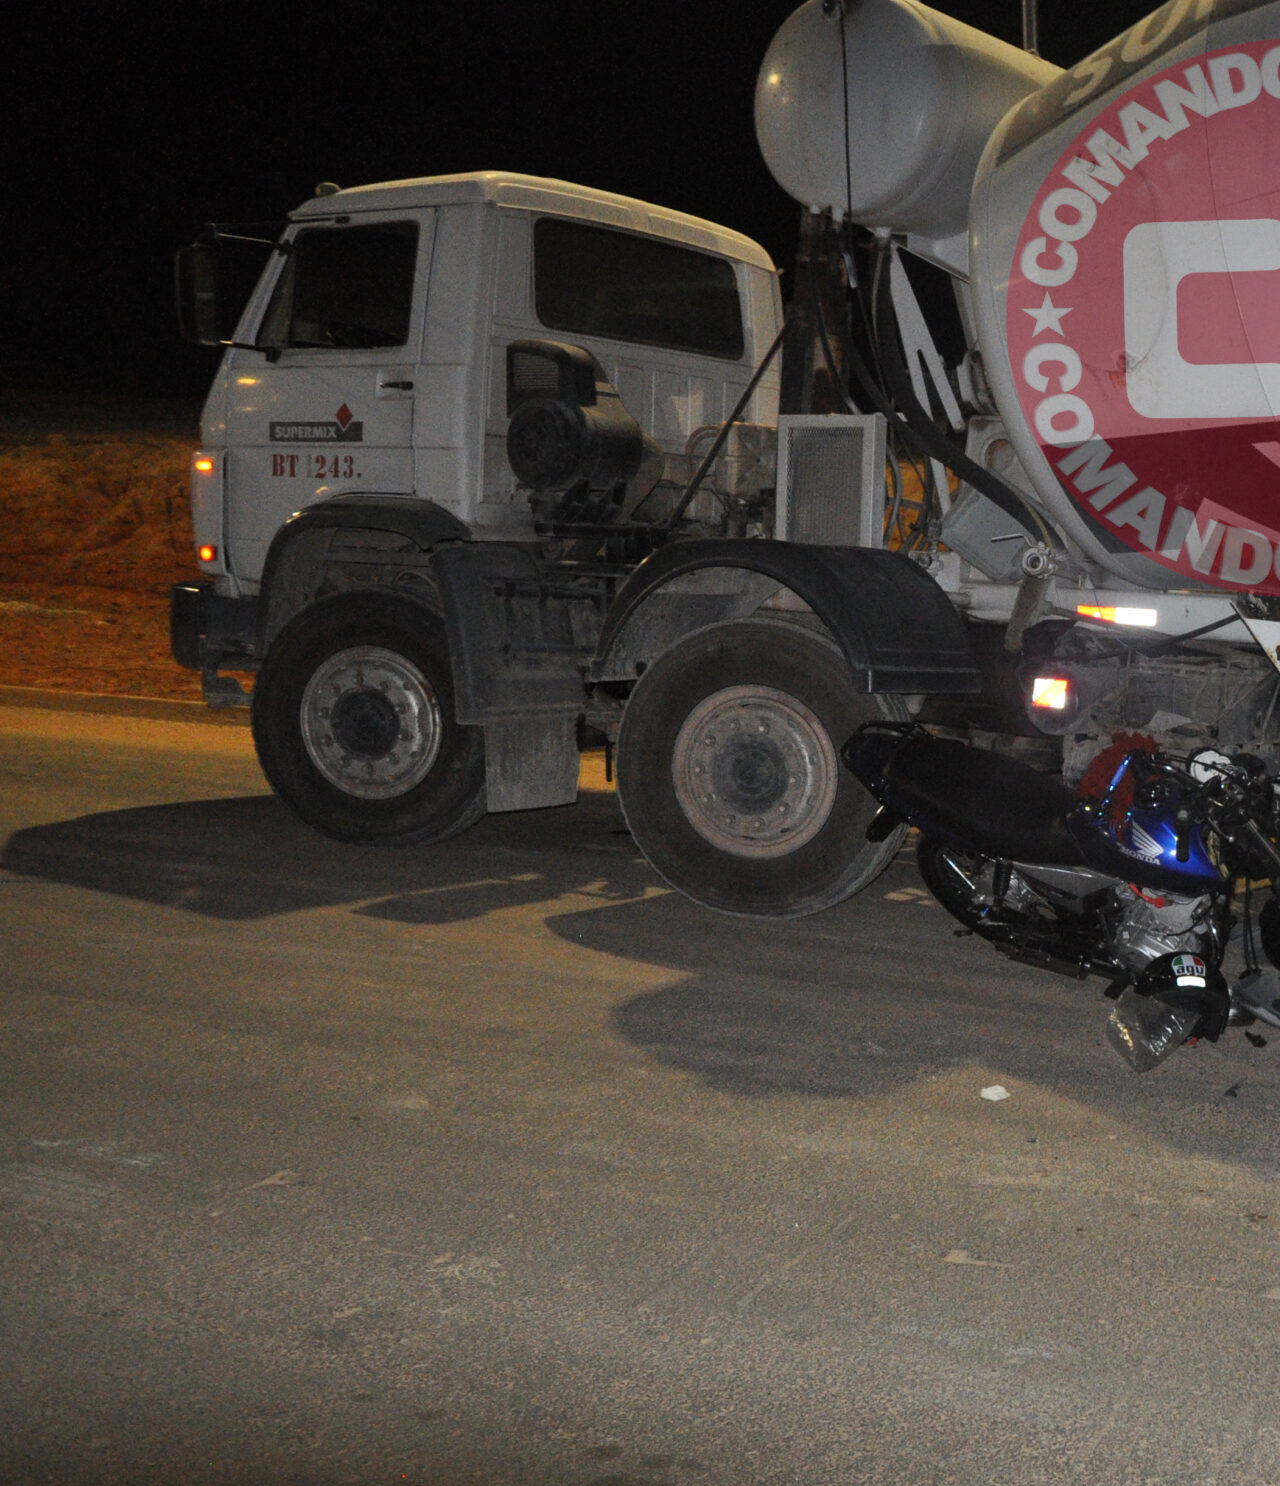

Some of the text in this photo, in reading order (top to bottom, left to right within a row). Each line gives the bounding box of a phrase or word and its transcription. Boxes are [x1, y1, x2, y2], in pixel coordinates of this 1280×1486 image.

[274, 426, 337, 438] SUPERMIX
[272, 454, 299, 478] BT
[1119, 846, 1161, 865] HONDA
